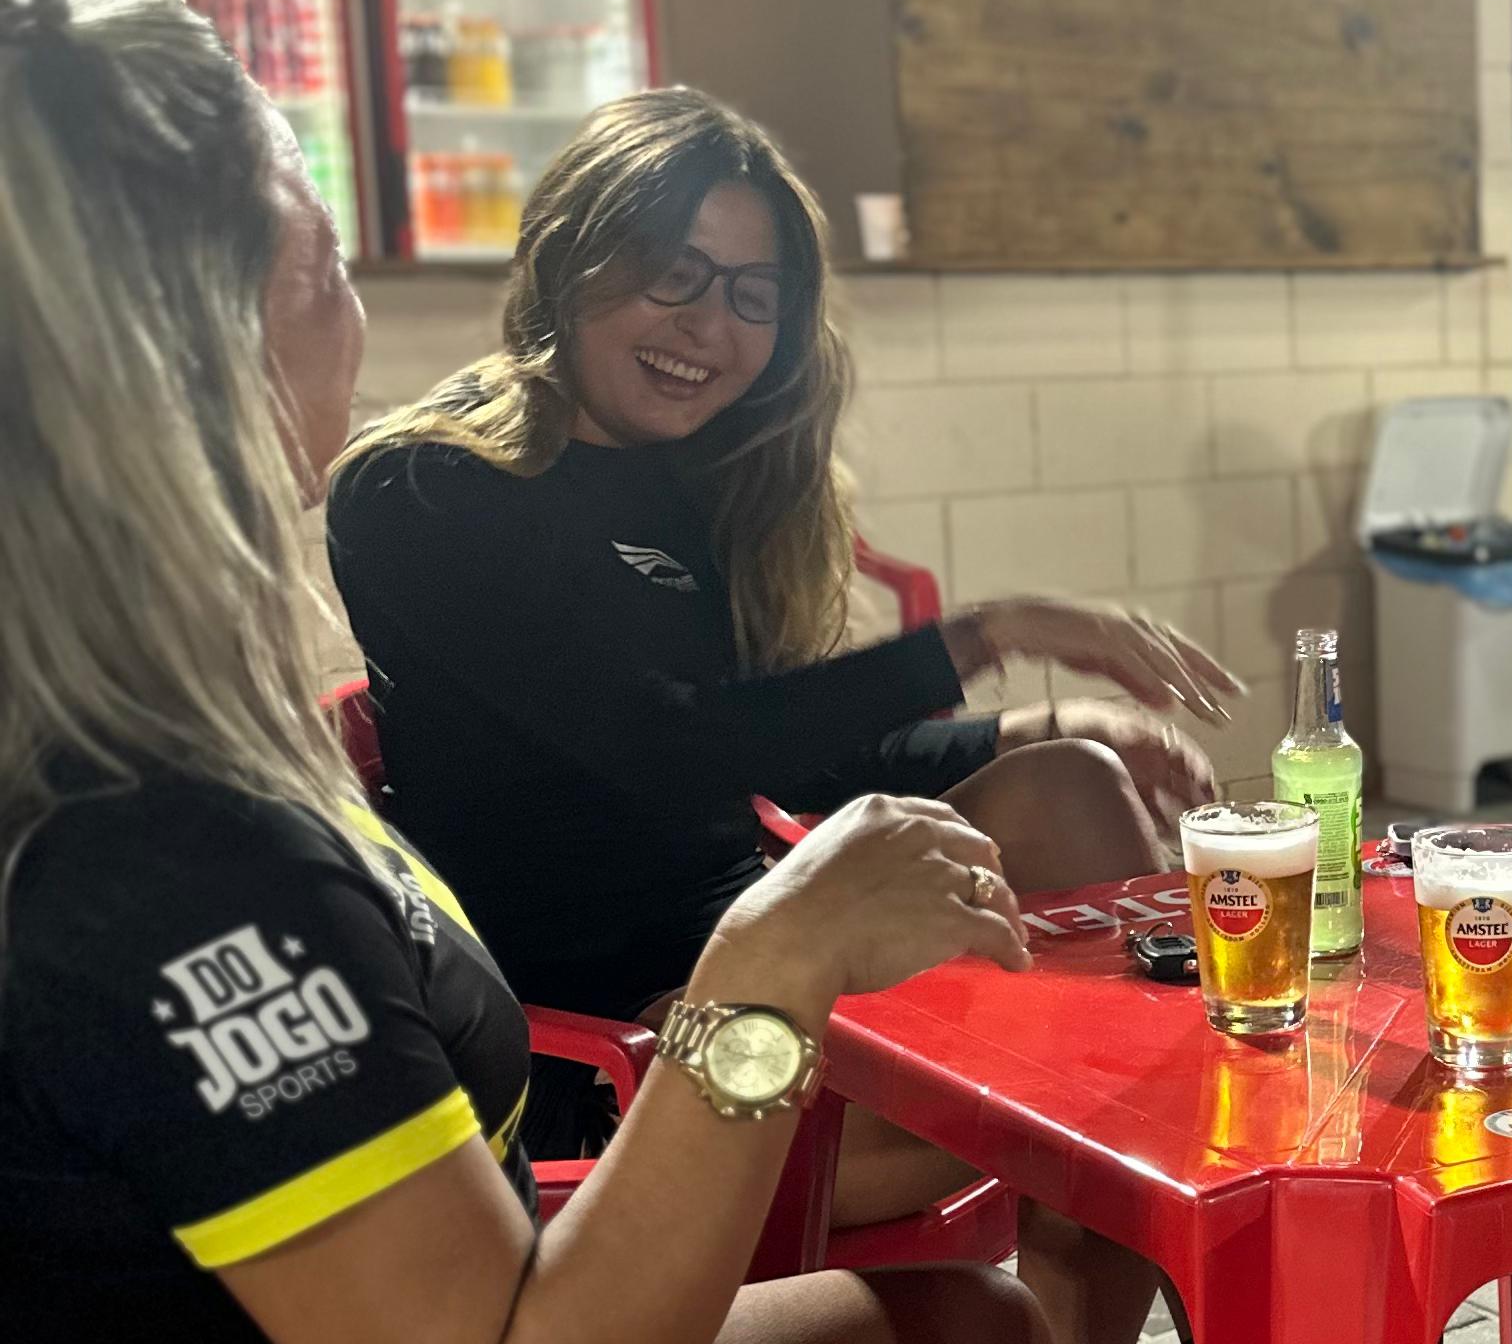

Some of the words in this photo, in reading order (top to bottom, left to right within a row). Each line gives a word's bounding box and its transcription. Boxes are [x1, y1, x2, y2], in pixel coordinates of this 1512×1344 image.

[1209, 894, 1259, 907] AMSTEL
[1456, 922, 1509, 936] AMSTEL
[1468, 939, 1498, 949] LAGER
[186, 943, 263, 1009] DO
[166, 967, 370, 1113] JOGO
[239, 1049, 358, 1119] SPORTS
